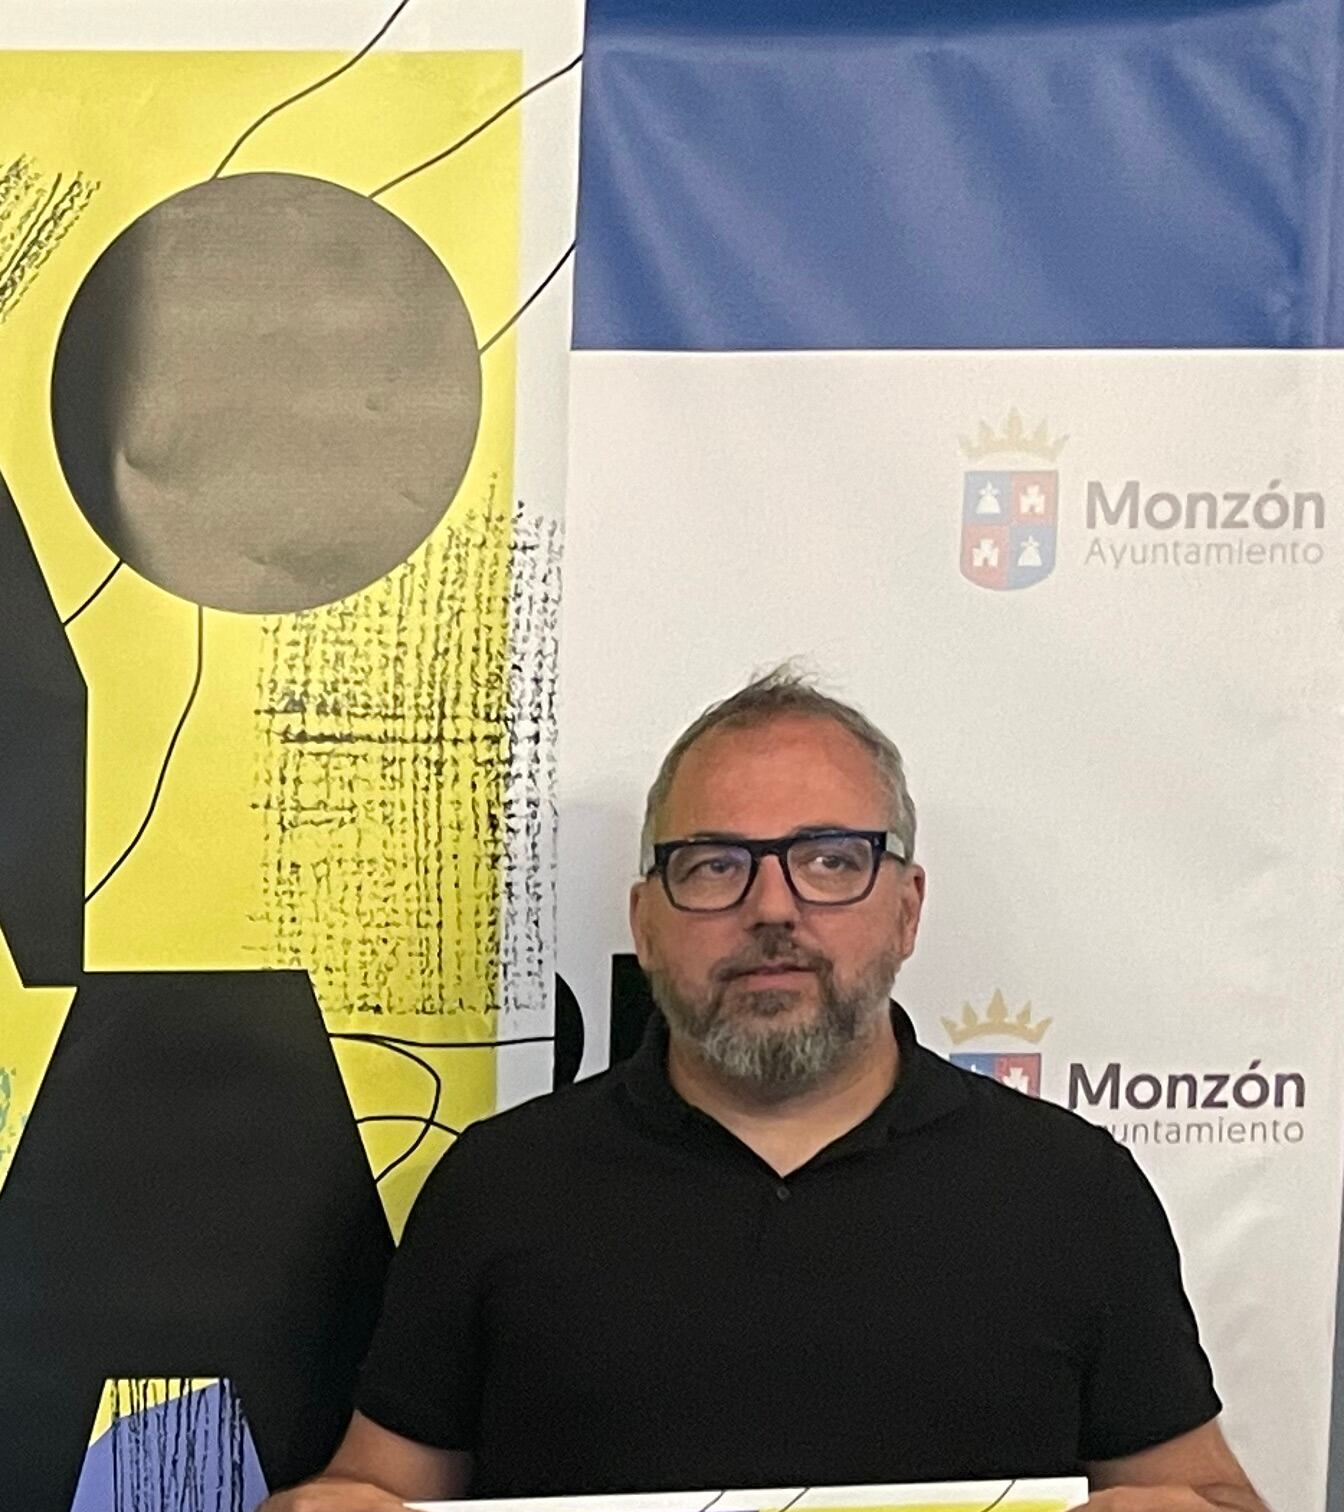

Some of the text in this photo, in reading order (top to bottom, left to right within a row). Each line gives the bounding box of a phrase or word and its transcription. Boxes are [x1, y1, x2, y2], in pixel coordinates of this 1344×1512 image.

[1085, 478, 1326, 531] Monzón
[1085, 536, 1324, 570] Ayuntamiento
[1068, 1059, 1306, 1110] Monzón
